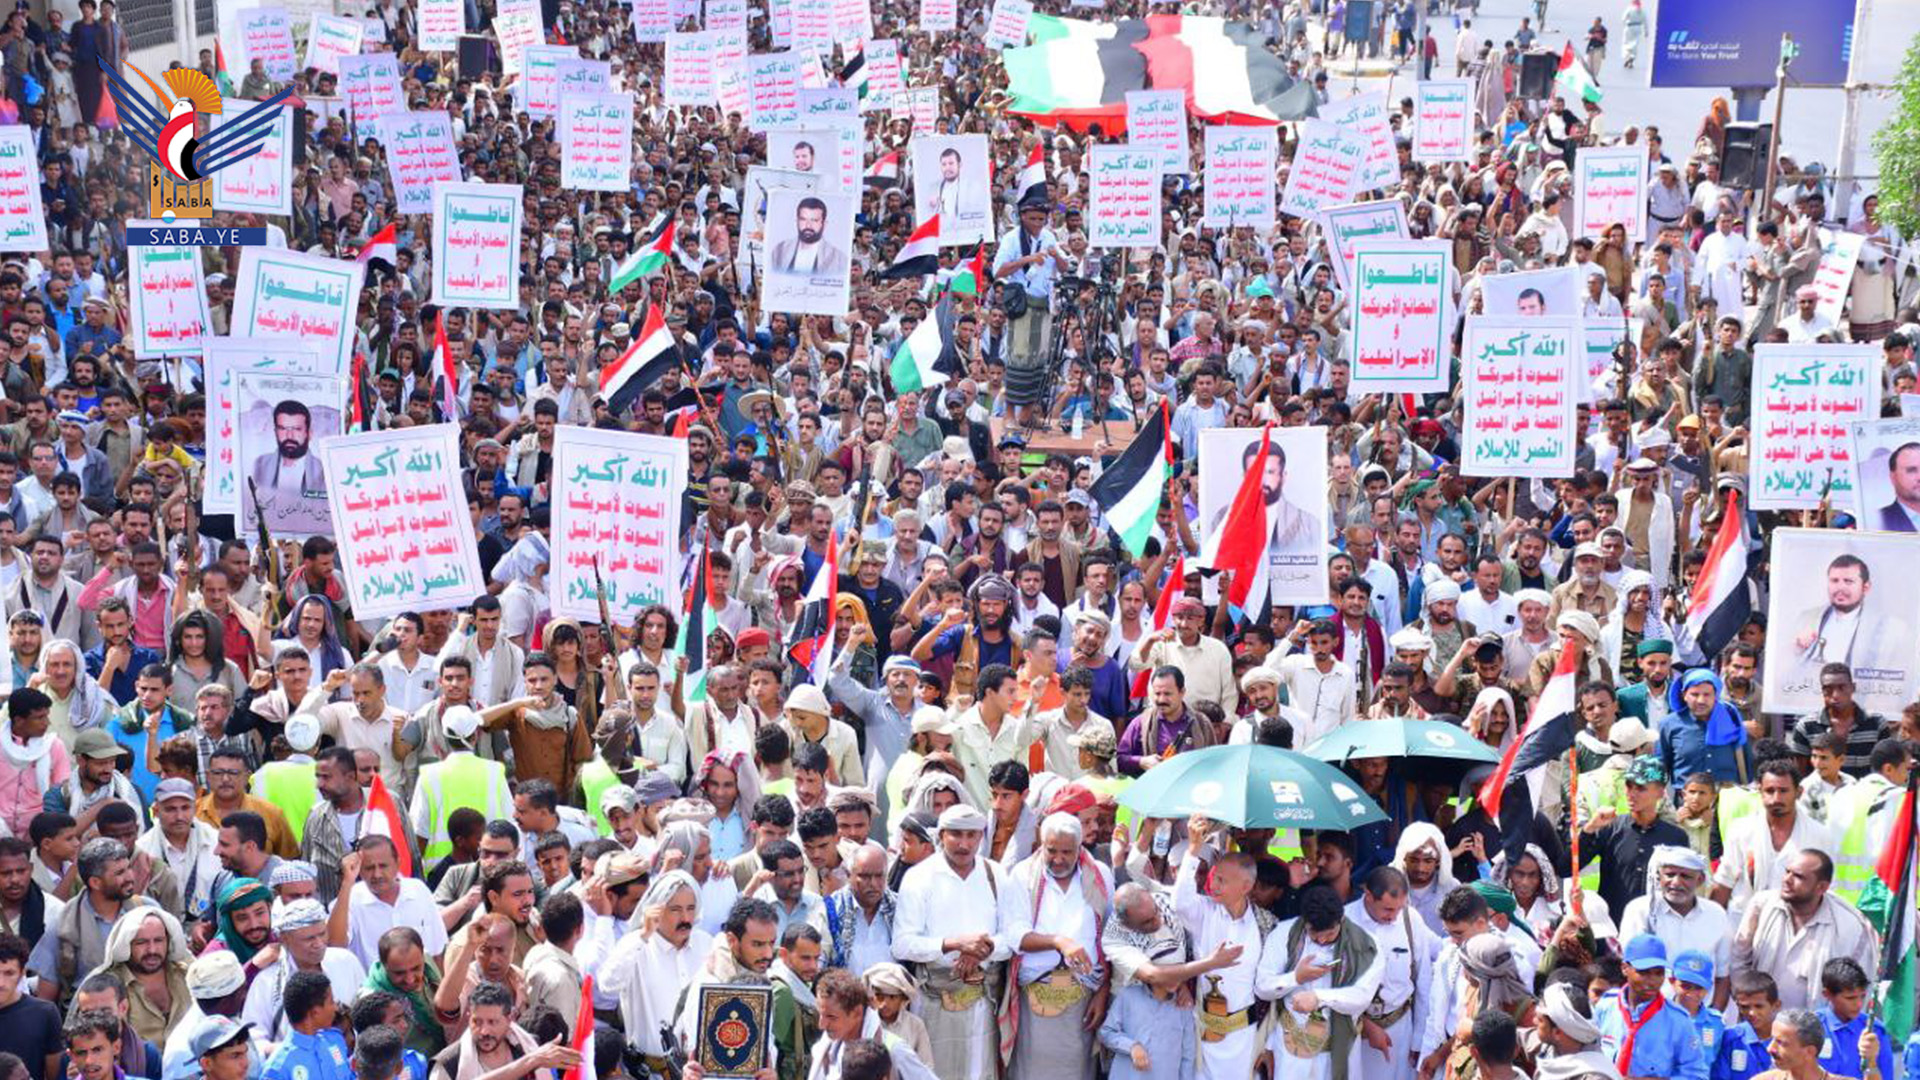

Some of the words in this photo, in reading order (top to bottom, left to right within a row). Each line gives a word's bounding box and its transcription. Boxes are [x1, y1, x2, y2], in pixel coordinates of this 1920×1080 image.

[1133, 155, 1153, 169] الله
[449, 201, 510, 225] قاطعوا
[1362, 263, 1438, 290] قاطعوا
[261, 272, 343, 306] قاطعوا
[1478, 330, 1531, 363] أكبر
[1532, 334, 1564, 356] الله
[1477, 365, 1522, 386] لأمريكا
[1526, 367, 1564, 385] الموت
[1477, 389, 1522, 410] لإسرائيل
[1526, 392, 1563, 409] الموت
[1475, 415, 1507, 433] اليهود
[1512, 416, 1529, 432] على
[1534, 414, 1563, 429] اللعنة
[405, 446, 442, 472] الله
[1476, 438, 1520, 464] للإسلام
[1524, 437, 1563, 463] النصر
[340, 445, 399, 488] أكبر
[568, 453, 629, 488] أكبر
[631, 460, 667, 489] الله
[344, 484, 400, 512] لأمريكا
[404, 484, 448, 506] الموت
[568, 491, 621, 515] لأمريكا
[409, 510, 453, 533] الموت
[624, 501, 665, 520] الموت
[351, 515, 406, 542] لإسرائيل
[568, 520, 620, 546] لإسرائيل
[624, 528, 664, 548] الموت
[356, 544, 394, 568] اليهود
[400, 542, 420, 563] على
[425, 537, 459, 555] اللعنة
[609, 552, 628, 572] على
[633, 553, 664, 576] اللعنة
[363, 569, 415, 602] للإسلام
[422, 562, 466, 596] النصر
[621, 582, 664, 610] النصر
